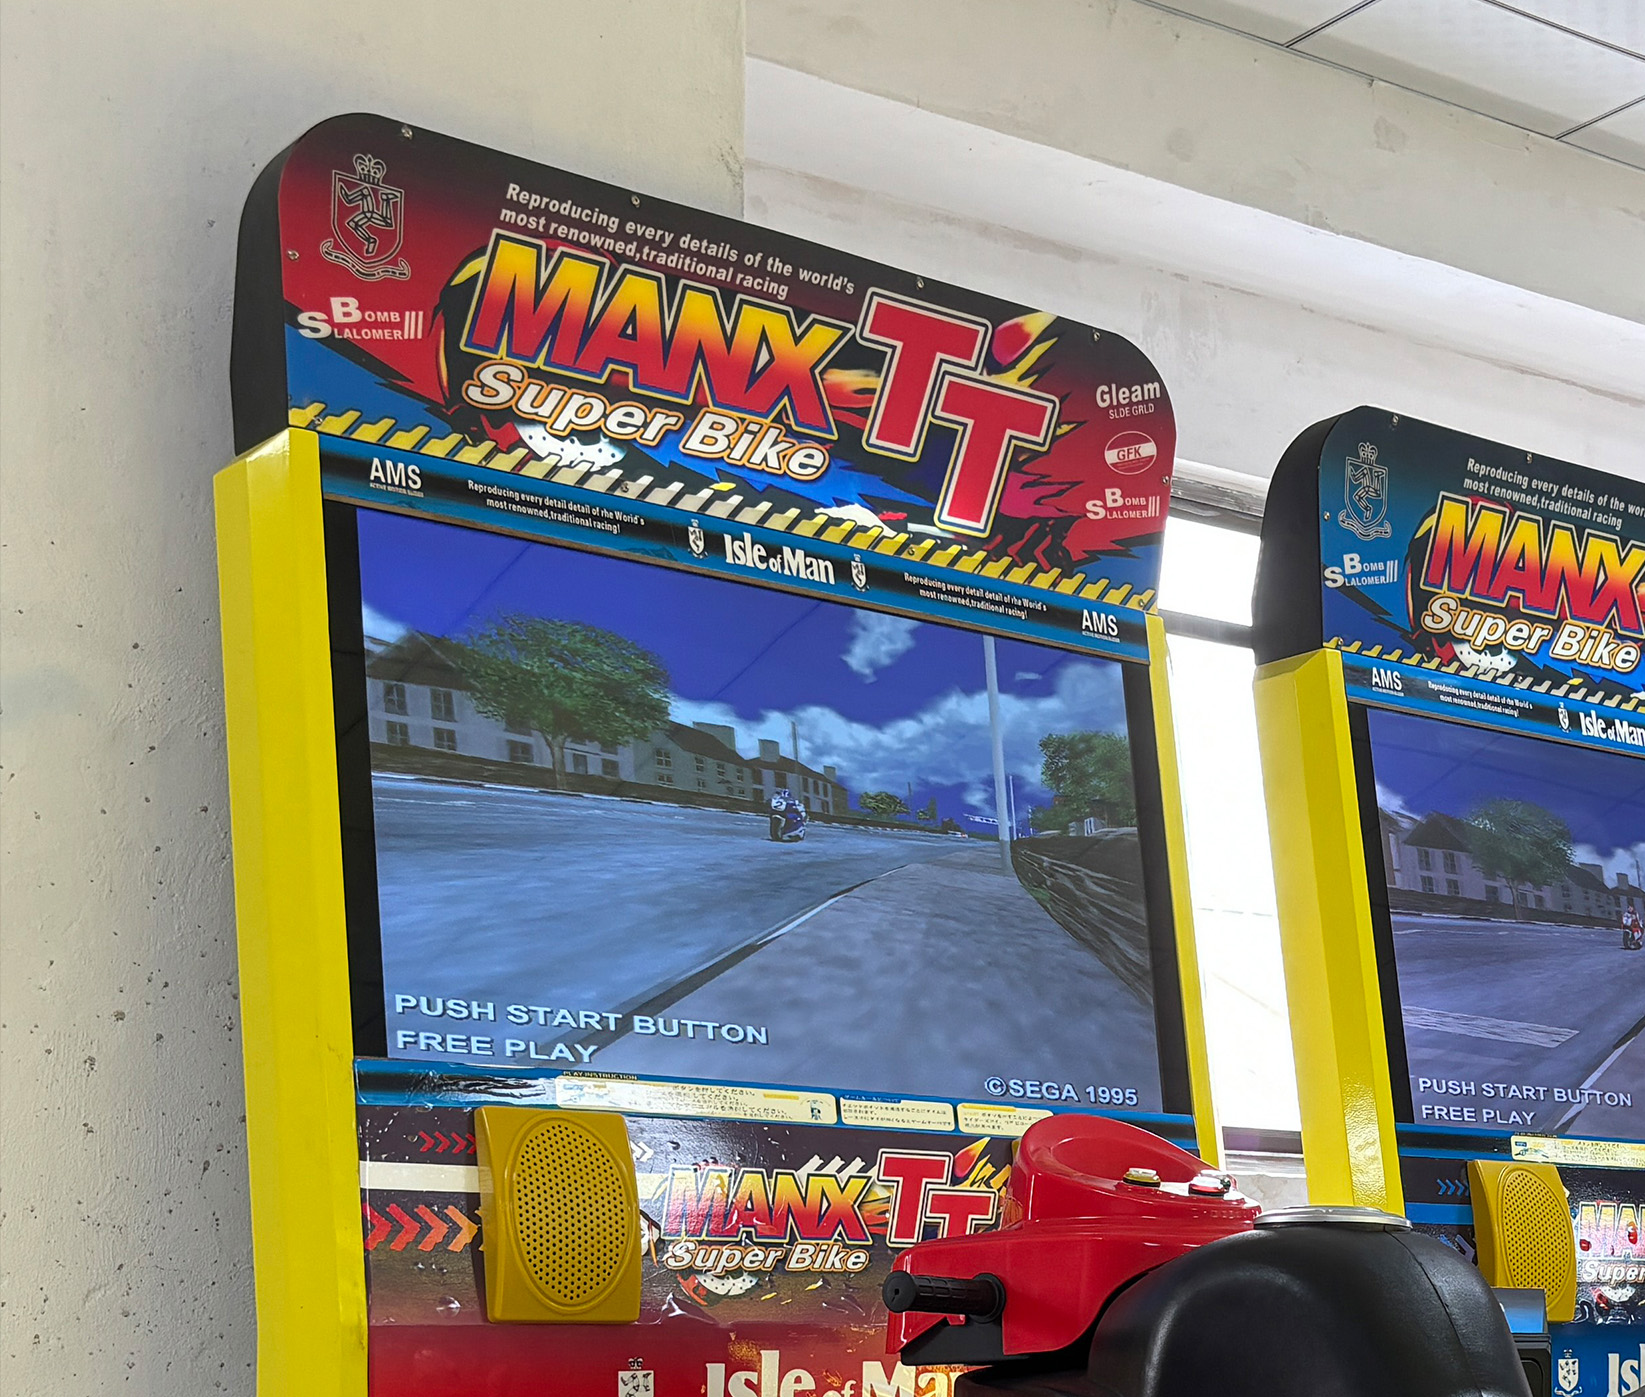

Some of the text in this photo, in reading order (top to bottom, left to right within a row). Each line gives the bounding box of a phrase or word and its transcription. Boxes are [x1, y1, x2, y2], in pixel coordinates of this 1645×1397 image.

[500, 209, 546, 232] most
[737, 271, 788, 300] racing
[506, 183, 855, 295] Reproducing every details of the world's
[462, 228, 1060, 538] MANX TT
[1096, 381, 1160, 408] Gleam
[462, 360, 830, 480] Super Bike
[1117, 446, 1142, 461] GFK
[370, 457, 422, 490] AMS
[1467, 457, 1528, 489] Reproducing
[1532, 478, 1559, 498] every
[1562, 484, 1594, 504] details
[1598, 495, 1608, 506] of
[1610, 497, 1625, 512] the
[468, 480, 520, 501] Reproducing
[521, 492, 543, 506] every
[544, 496, 566, 511] detail
[568, 500, 590, 515] detail
[487, 498, 506, 511] most
[1464, 478, 1488, 494] most
[1593, 512, 1622, 531] racing
[723, 532, 836, 585] Isle of Man
[904, 572, 946, 592] Reproducing
[1082, 609, 1118, 636] AMS
[1421, 595, 1641, 672] Super Bike
[1371, 667, 1402, 691] AMS
[1579, 709, 1607, 739] Isle
[1607, 727, 1615, 741] of
[395, 993, 769, 1045] PUSH START BUTTON
[396, 1030, 598, 1064] FREE PLAY
[1086, 1084, 1138, 1106] 1995
[1419, 1077, 1633, 1107] PUSH START BUTTON
[1422, 1105, 1536, 1126] FREE PLAY
[661, 1164, 874, 1246] MANX
[665, 1241, 869, 1275] Super Bike
